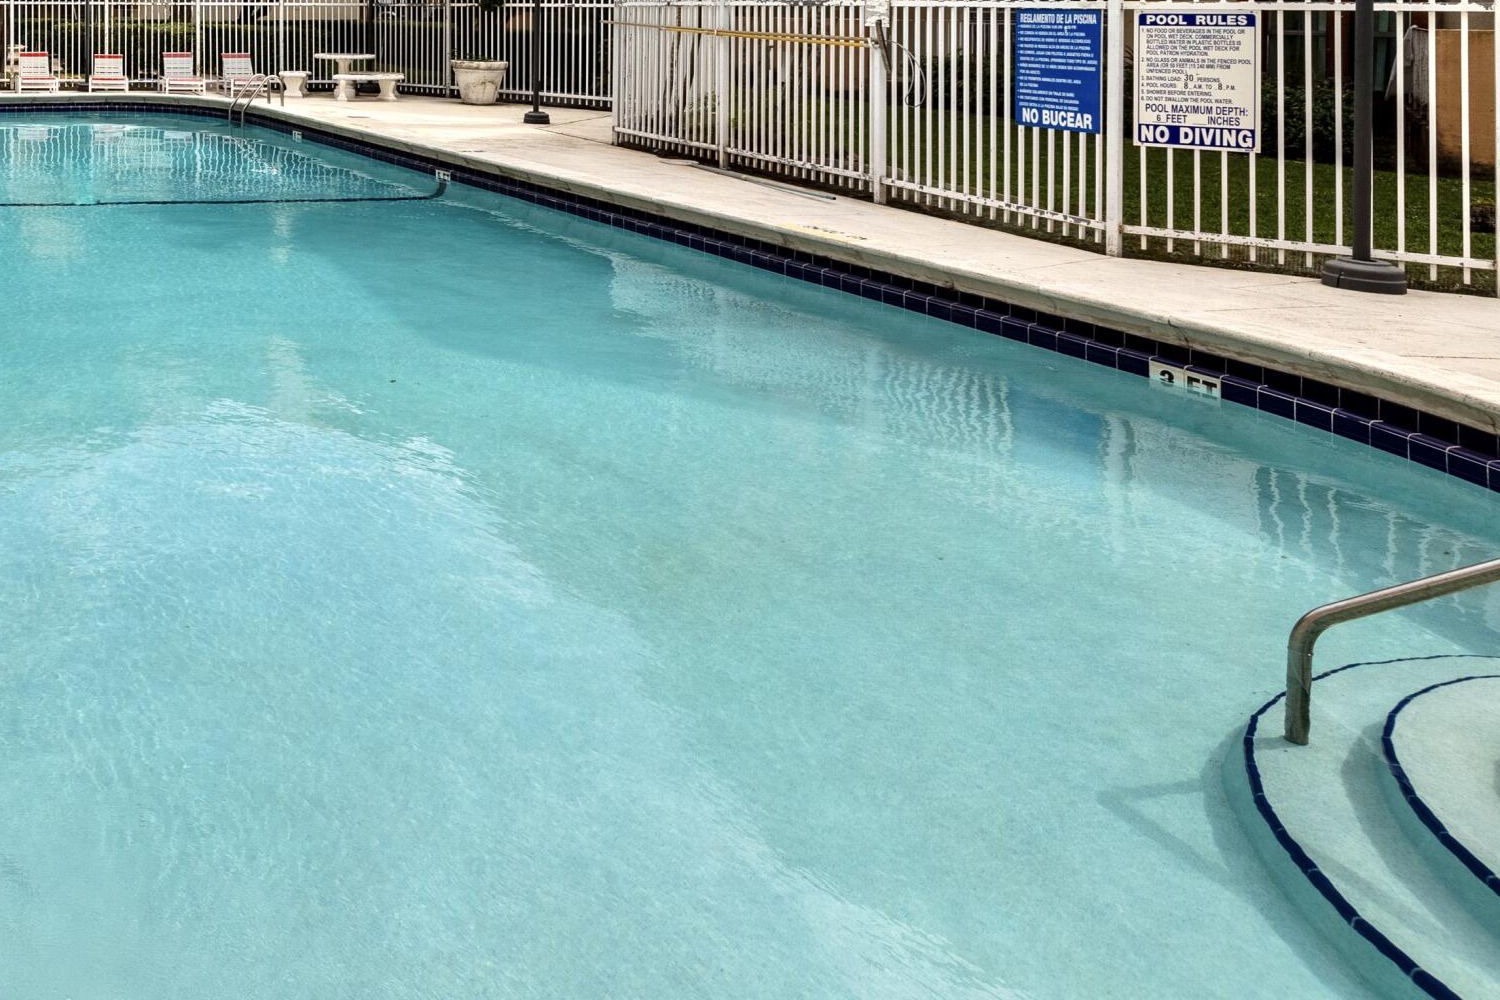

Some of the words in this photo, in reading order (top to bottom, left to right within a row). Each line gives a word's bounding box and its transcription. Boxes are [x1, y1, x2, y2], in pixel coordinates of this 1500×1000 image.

[1020, 14, 1055, 23] REGLAMENTO
[1056, 14, 1064, 24] DE
[1065, 14, 1072, 24] LA
[1074, 14, 1097, 24] PISCINA
[1146, 15, 1187, 25] POOL
[1195, 15, 1248, 25] RULES
[1145, 103, 1168, 113] POOL
[1171, 104, 1212, 114] MAXIMUM
[1216, 106, 1248, 116] DEPTH:
[1022, 108, 1039, 123] NO
[1042, 110, 1092, 129] BUCEAR
[1166, 114, 1187, 123] FEET
[1208, 116, 1240, 126] INCHES
[1140, 125, 1170, 143] NO
[1180, 127, 1253, 148] DIVING
